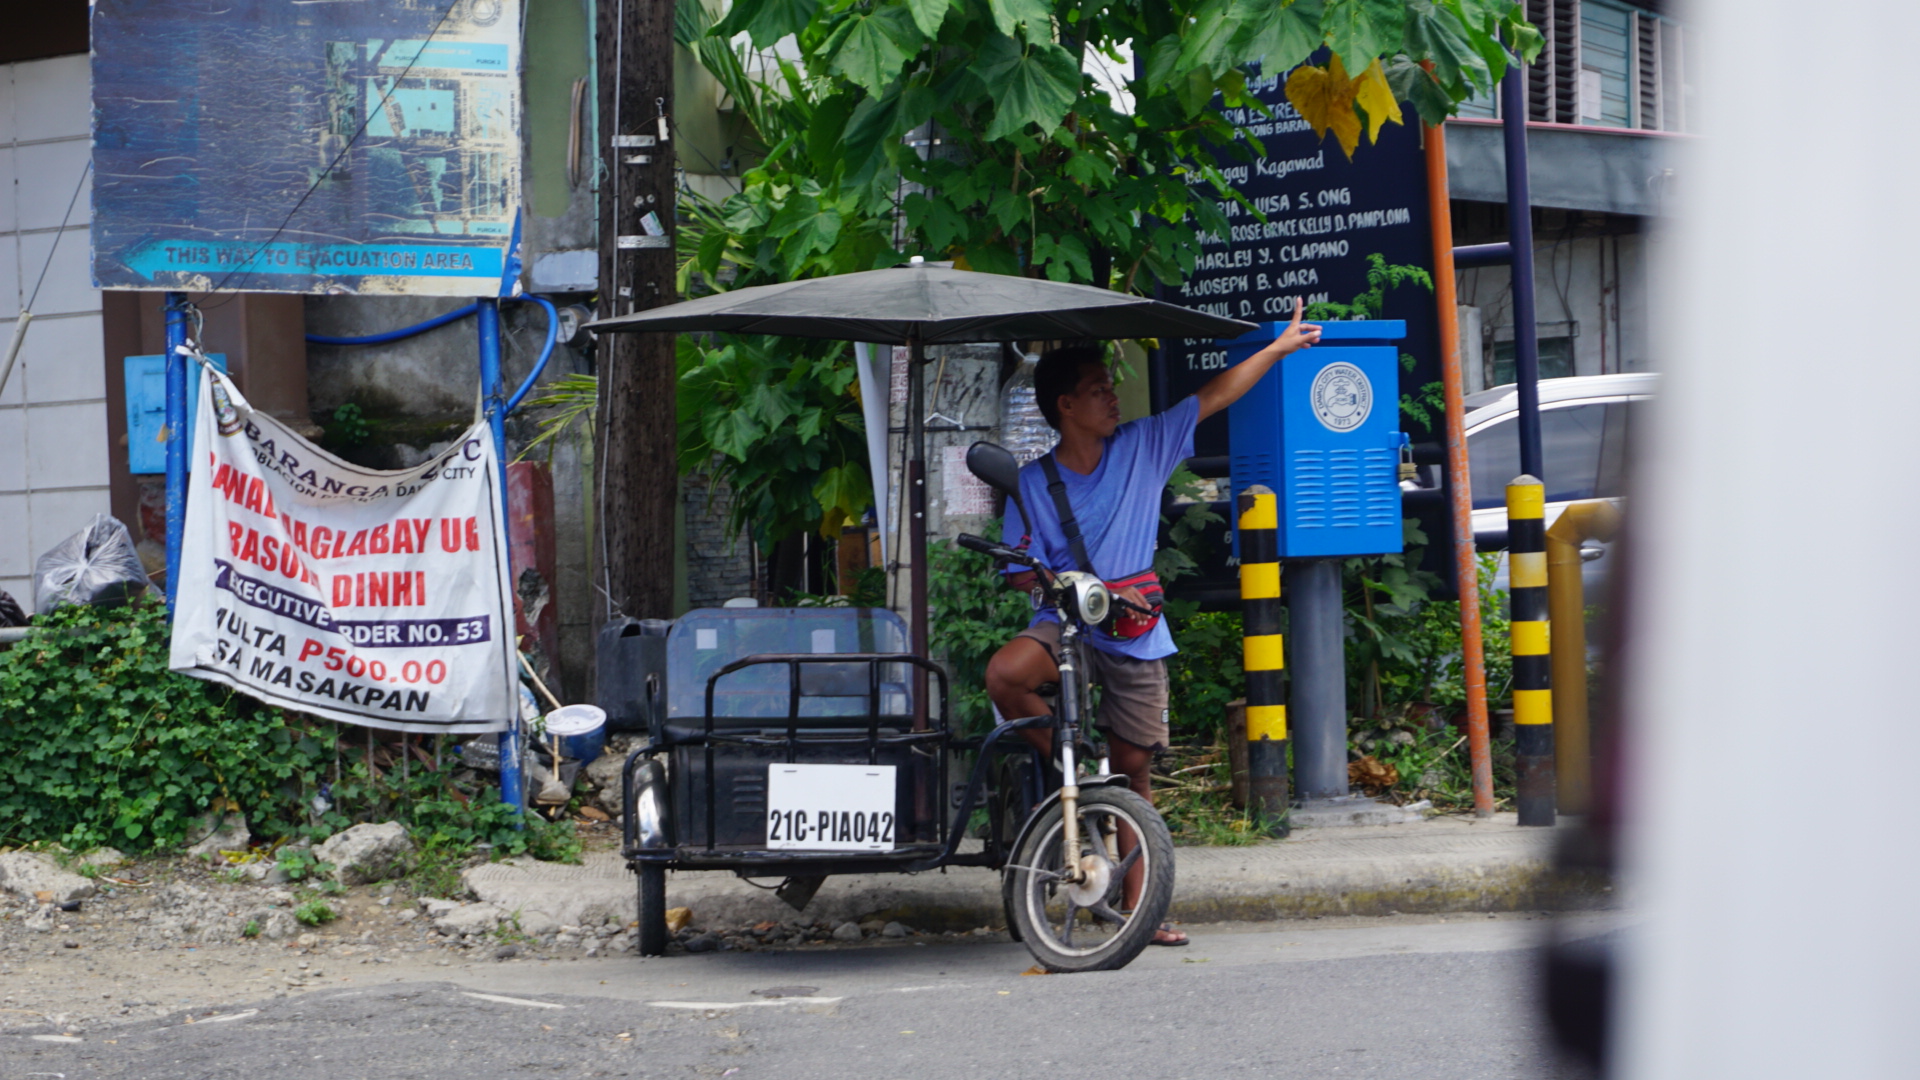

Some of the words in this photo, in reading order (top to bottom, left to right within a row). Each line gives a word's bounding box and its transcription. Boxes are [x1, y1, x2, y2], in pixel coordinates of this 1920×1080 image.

[1220, 108, 1246, 126] RIA
[1248, 101, 1302, 124] ESTREL
[1234, 123, 1274, 139] PUONG
[1275, 119, 1312, 134] BARAN
[1185, 165, 1249, 186] Bagay
[1256, 151, 1325, 178] Kagawad
[1299, 192, 1314, 209] S.
[1318, 187, 1351, 207] ONG
[1231, 223, 1262, 242] ROSE
[1263, 218, 1298, 239] GRACE
[1300, 215, 1332, 235] KELLY
[1335, 214, 1348, 232] D.
[1349, 208, 1411, 229] PAMPLONA
[166, 246, 210, 264] THIS
[215, 247, 255, 266] WAY
[265, 248, 289, 267] TO
[295, 250, 417, 269] EVACUATION
[422, 252, 474, 270] AREA
[1195, 248, 1252, 270] HARLEY
[1258, 248, 1274, 264] Y.
[1280, 240, 1349, 262] CLAPANO
[1256, 273, 1272, 290] B.
[1277, 268, 1319, 288] JARA
[1240, 299, 1255, 316] D.
[1263, 290, 1329, 314] CODIAN
[1186, 353, 1199, 370] 7.
[1201, 351, 1228, 370] EDD
[1321, 372, 1333, 384] CITY
[1335, 369, 1357, 380] WATER
[245, 419, 402, 498] BARANGA
[252, 446, 317, 498] BLACION
[442, 467, 476, 480] CITY
[440, 515, 480, 552] UG
[228, 519, 321, 592] BASU
[332, 571, 426, 608] DINHI
[228, 569, 331, 627] EXECUTIVE
[338, 623, 402, 645] RDER
[408, 623, 450, 643] NO.
[456, 620, 484, 642] 53
[211, 637, 243, 671] SA
[249, 655, 431, 712] MASAKPAN
[297, 637, 447, 685] P500.00
[769, 809, 894, 843] 21C-PIA042
